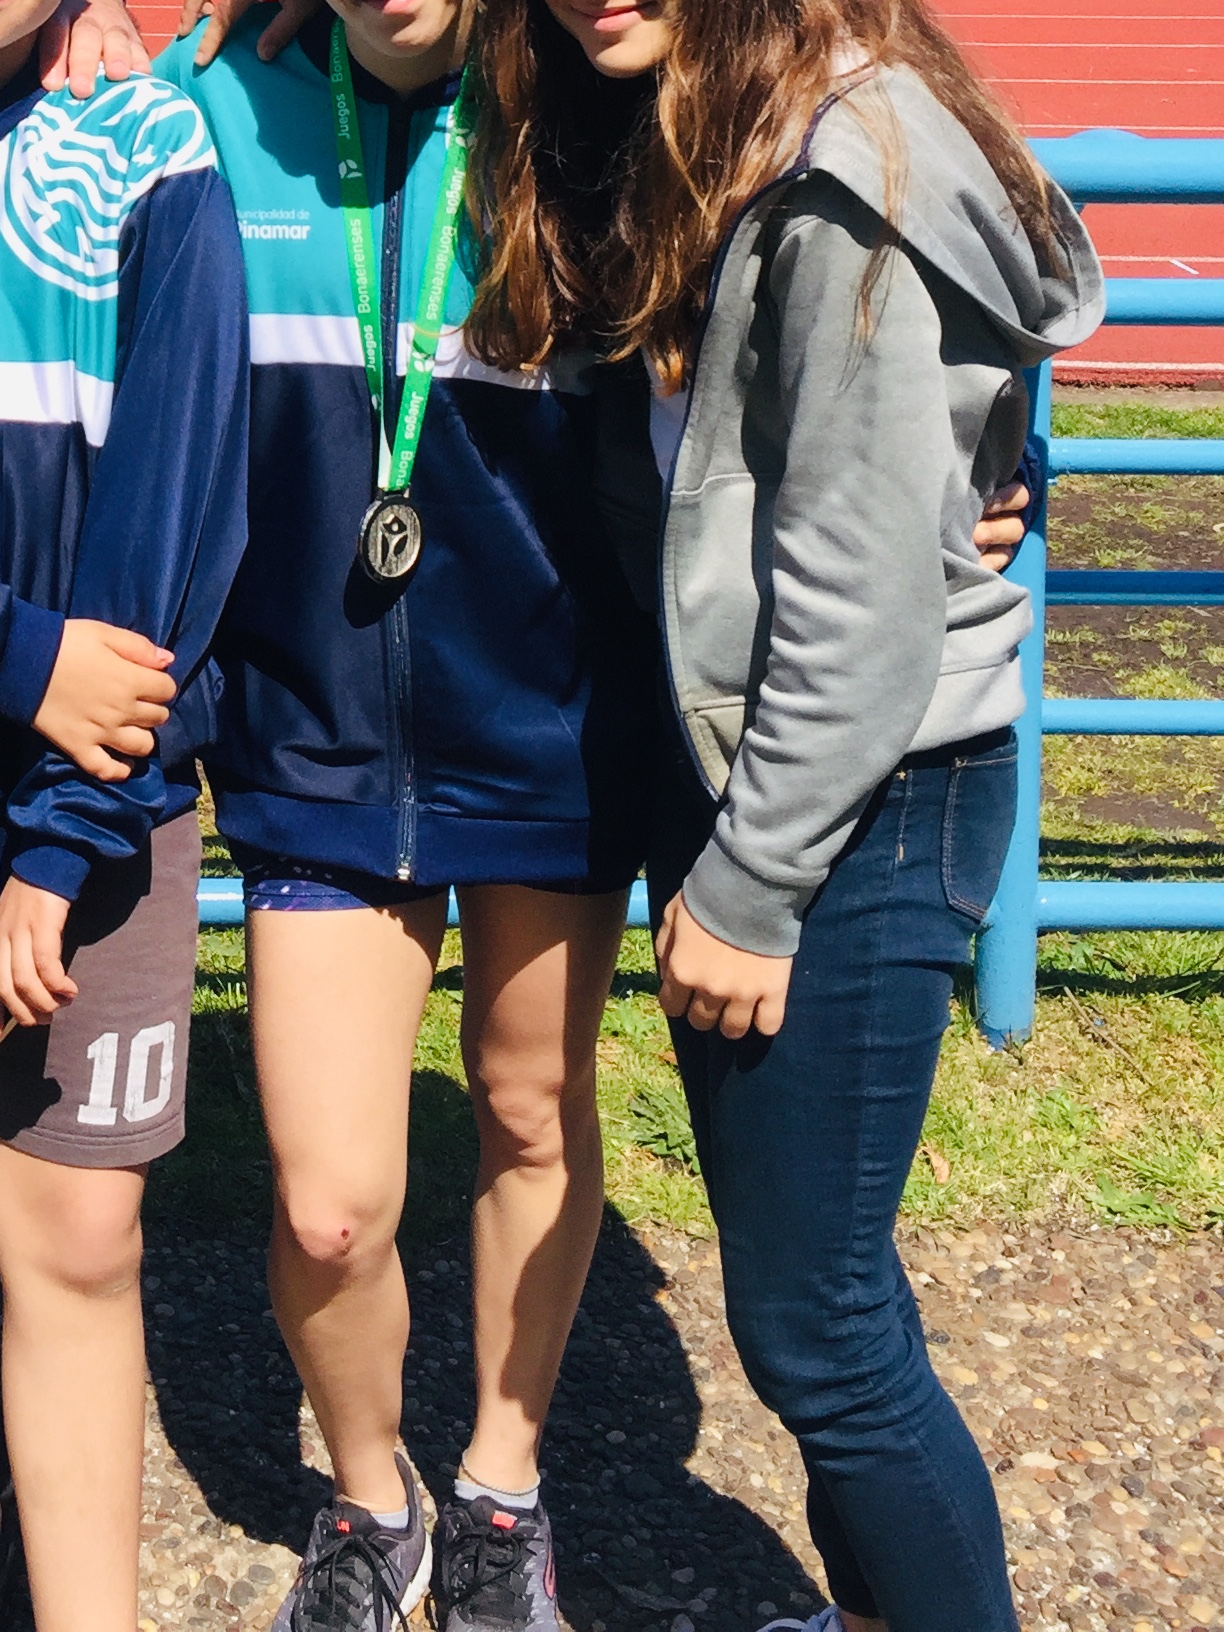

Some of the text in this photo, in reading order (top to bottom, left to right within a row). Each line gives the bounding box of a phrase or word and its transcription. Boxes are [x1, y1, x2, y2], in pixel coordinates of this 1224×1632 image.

[337, 93, 351, 140] Juegos
[297, 209, 310, 220] de
[425, 167, 466, 321] Juegos Bonaerenses
[350, 218, 377, 372] Juegos Bonaerenses
[404, 391, 424, 441] Juegos
[77, 1020, 176, 1126] 10
